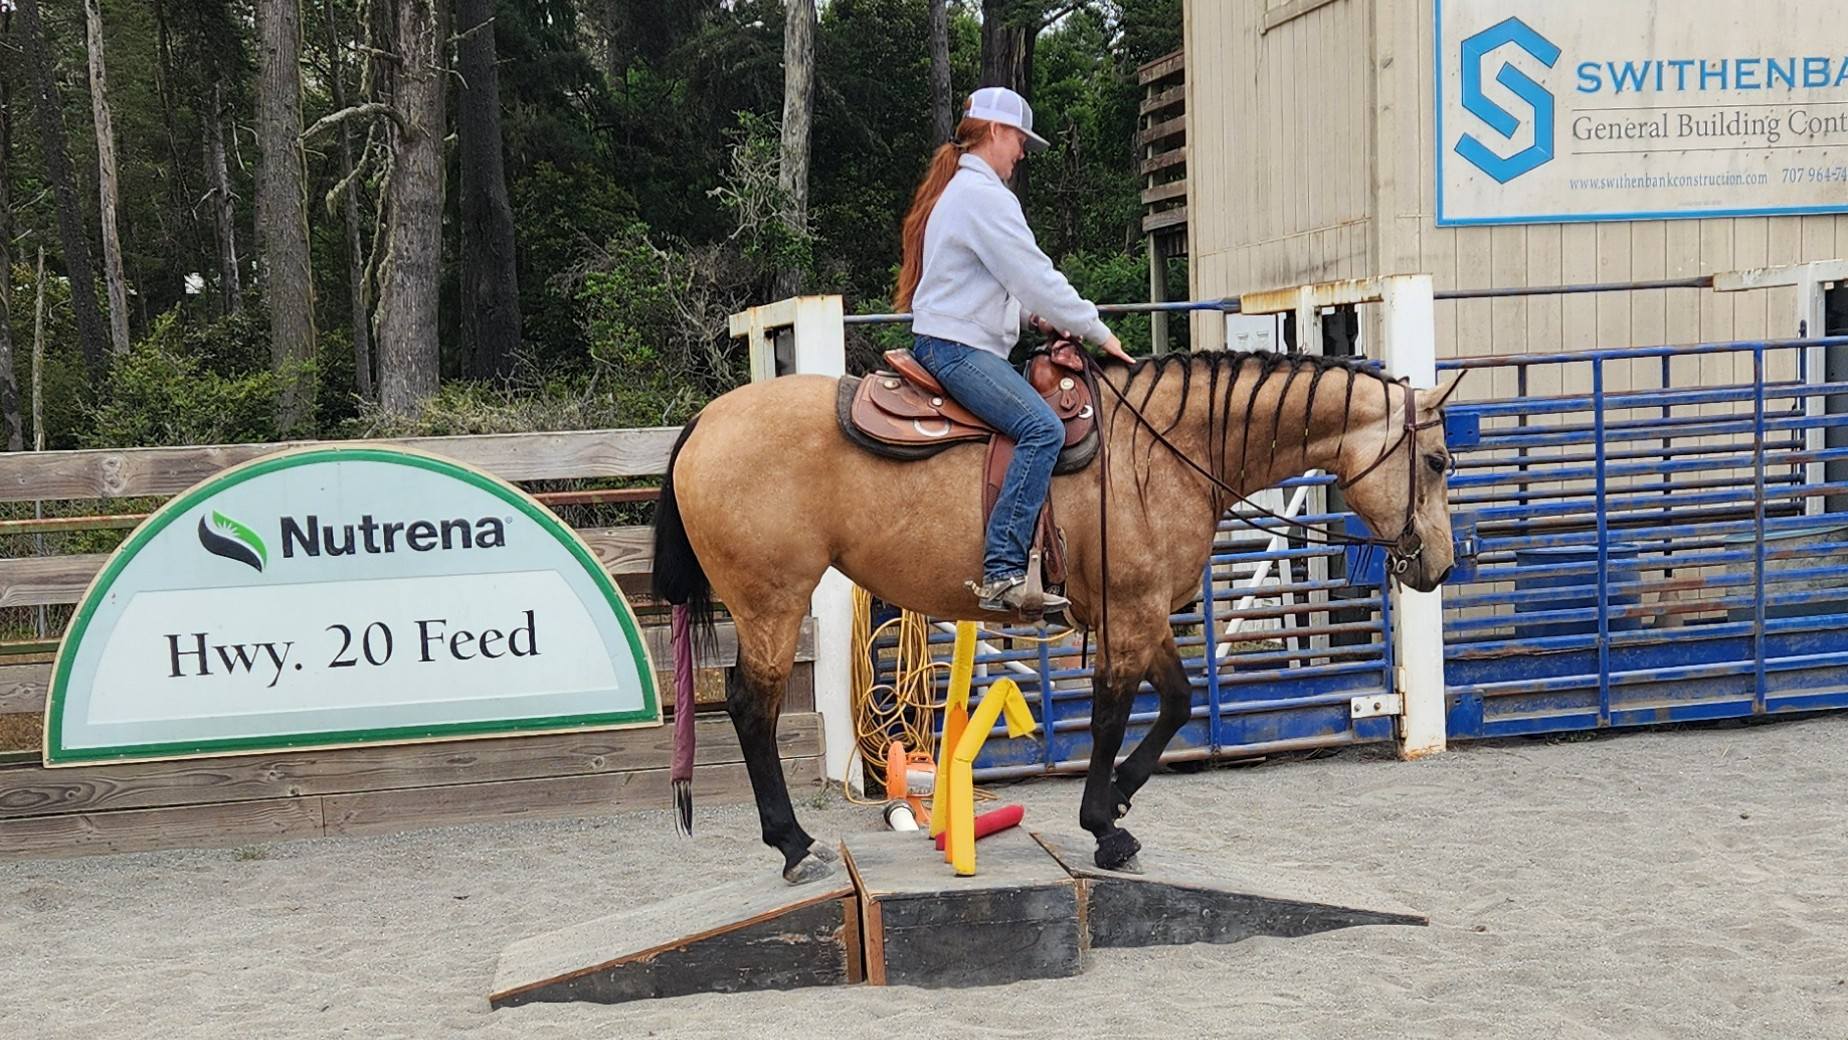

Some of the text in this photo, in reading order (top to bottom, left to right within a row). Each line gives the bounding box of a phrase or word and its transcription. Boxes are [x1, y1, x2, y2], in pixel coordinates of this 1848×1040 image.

[1572, 112, 1668, 141] General
[1677, 111, 1781, 144] Building
[1569, 172, 1768, 190] www.swithenbankconstruction.com
[1782, 168, 1804, 183] 707
[281, 516, 505, 558] Nutrena
[163, 609, 541, 688] Hwy. 20 Feed
